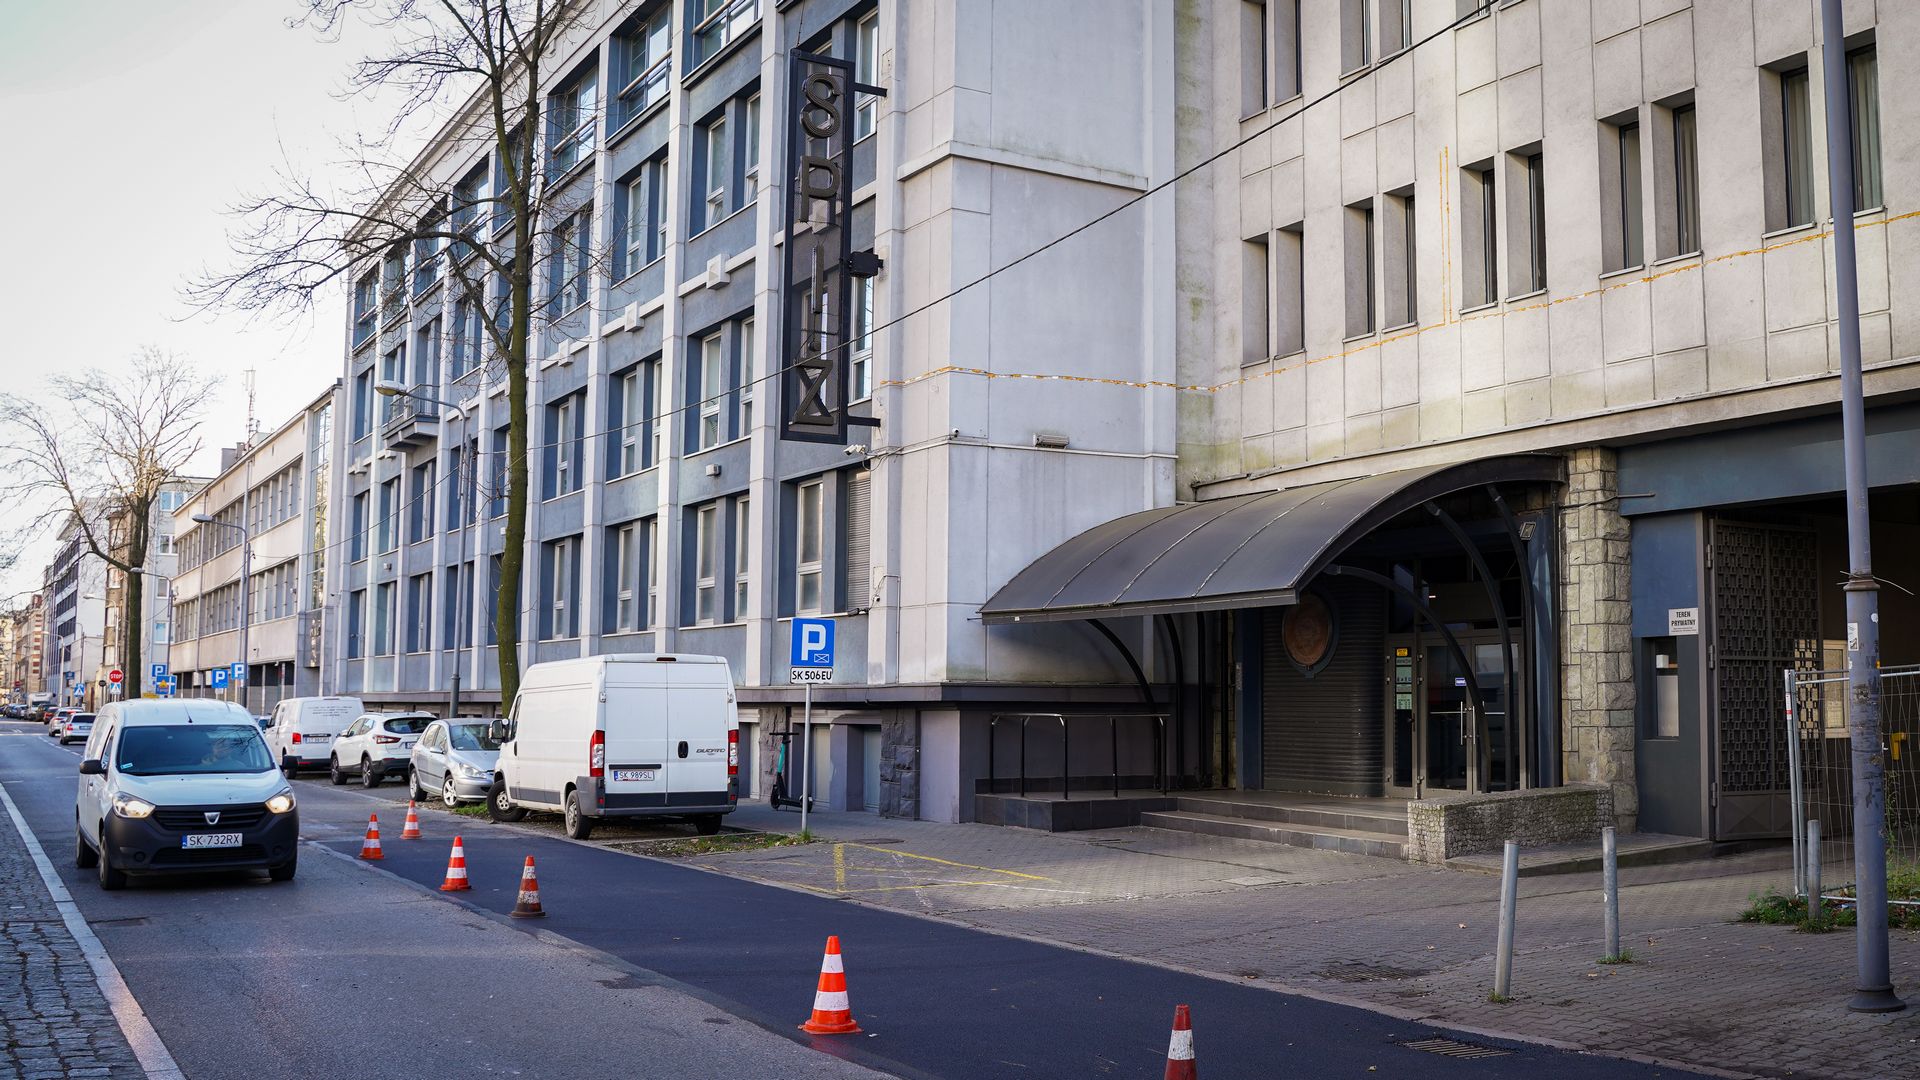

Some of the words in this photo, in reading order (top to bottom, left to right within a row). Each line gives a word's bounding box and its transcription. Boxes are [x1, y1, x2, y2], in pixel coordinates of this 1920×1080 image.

[1671, 619, 1696, 627] PRYWATNY
[801, 624, 827, 661] P
[155, 665, 164, 676] P
[234, 664, 245, 678] P
[792, 670, 803, 680] SK
[805, 670, 832, 680] 506EU
[215, 671, 226, 683] P
[631, 771, 652, 779] 989SL
[189, 836, 204, 846] SK
[207, 834, 240, 845] 732RX
